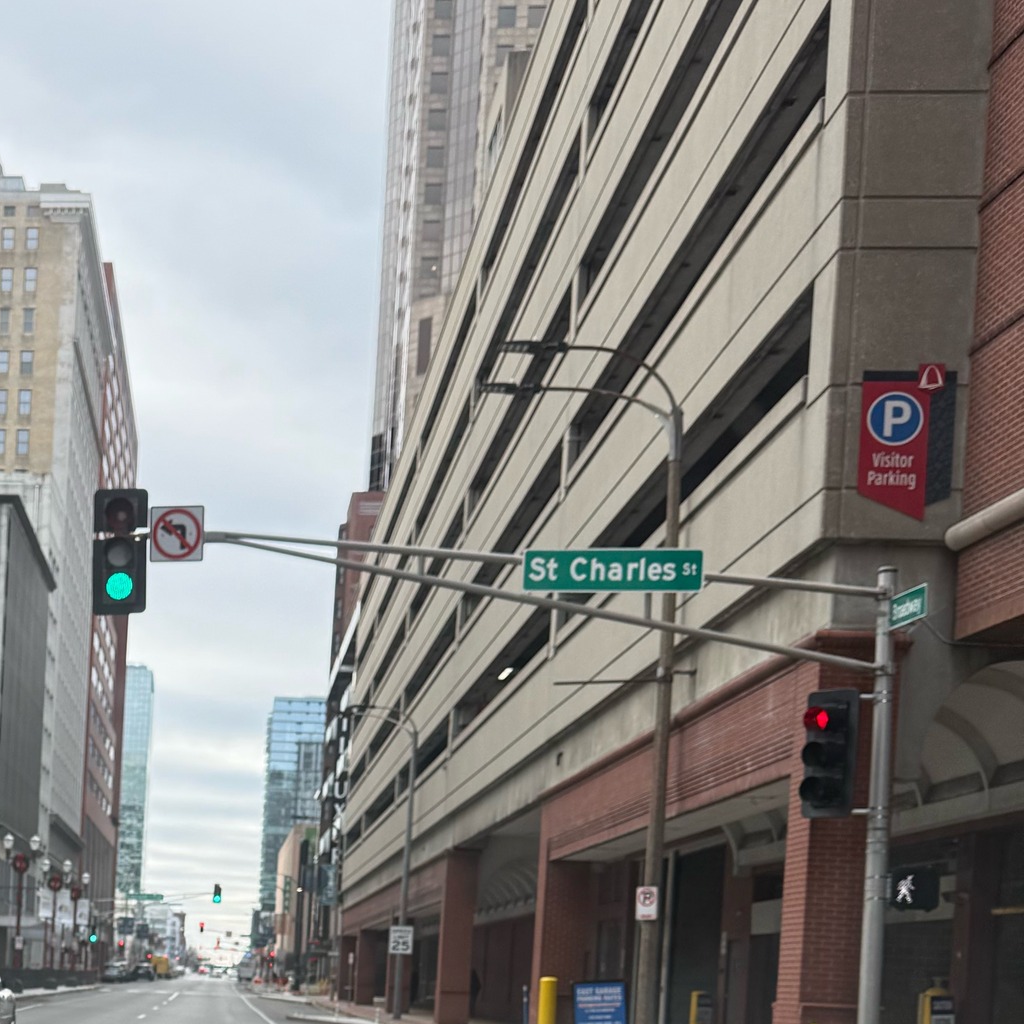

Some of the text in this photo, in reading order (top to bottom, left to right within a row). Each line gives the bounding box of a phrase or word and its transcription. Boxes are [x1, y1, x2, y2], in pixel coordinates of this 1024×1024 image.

[883, 400, 913, 438] P
[872, 452, 914, 468] Visitor
[867, 470, 917, 490] Parking
[528, 556, 698, 581] St Charles St
[892, 598, 923, 621] Broadway
[391, 940, 410, 952] 25
